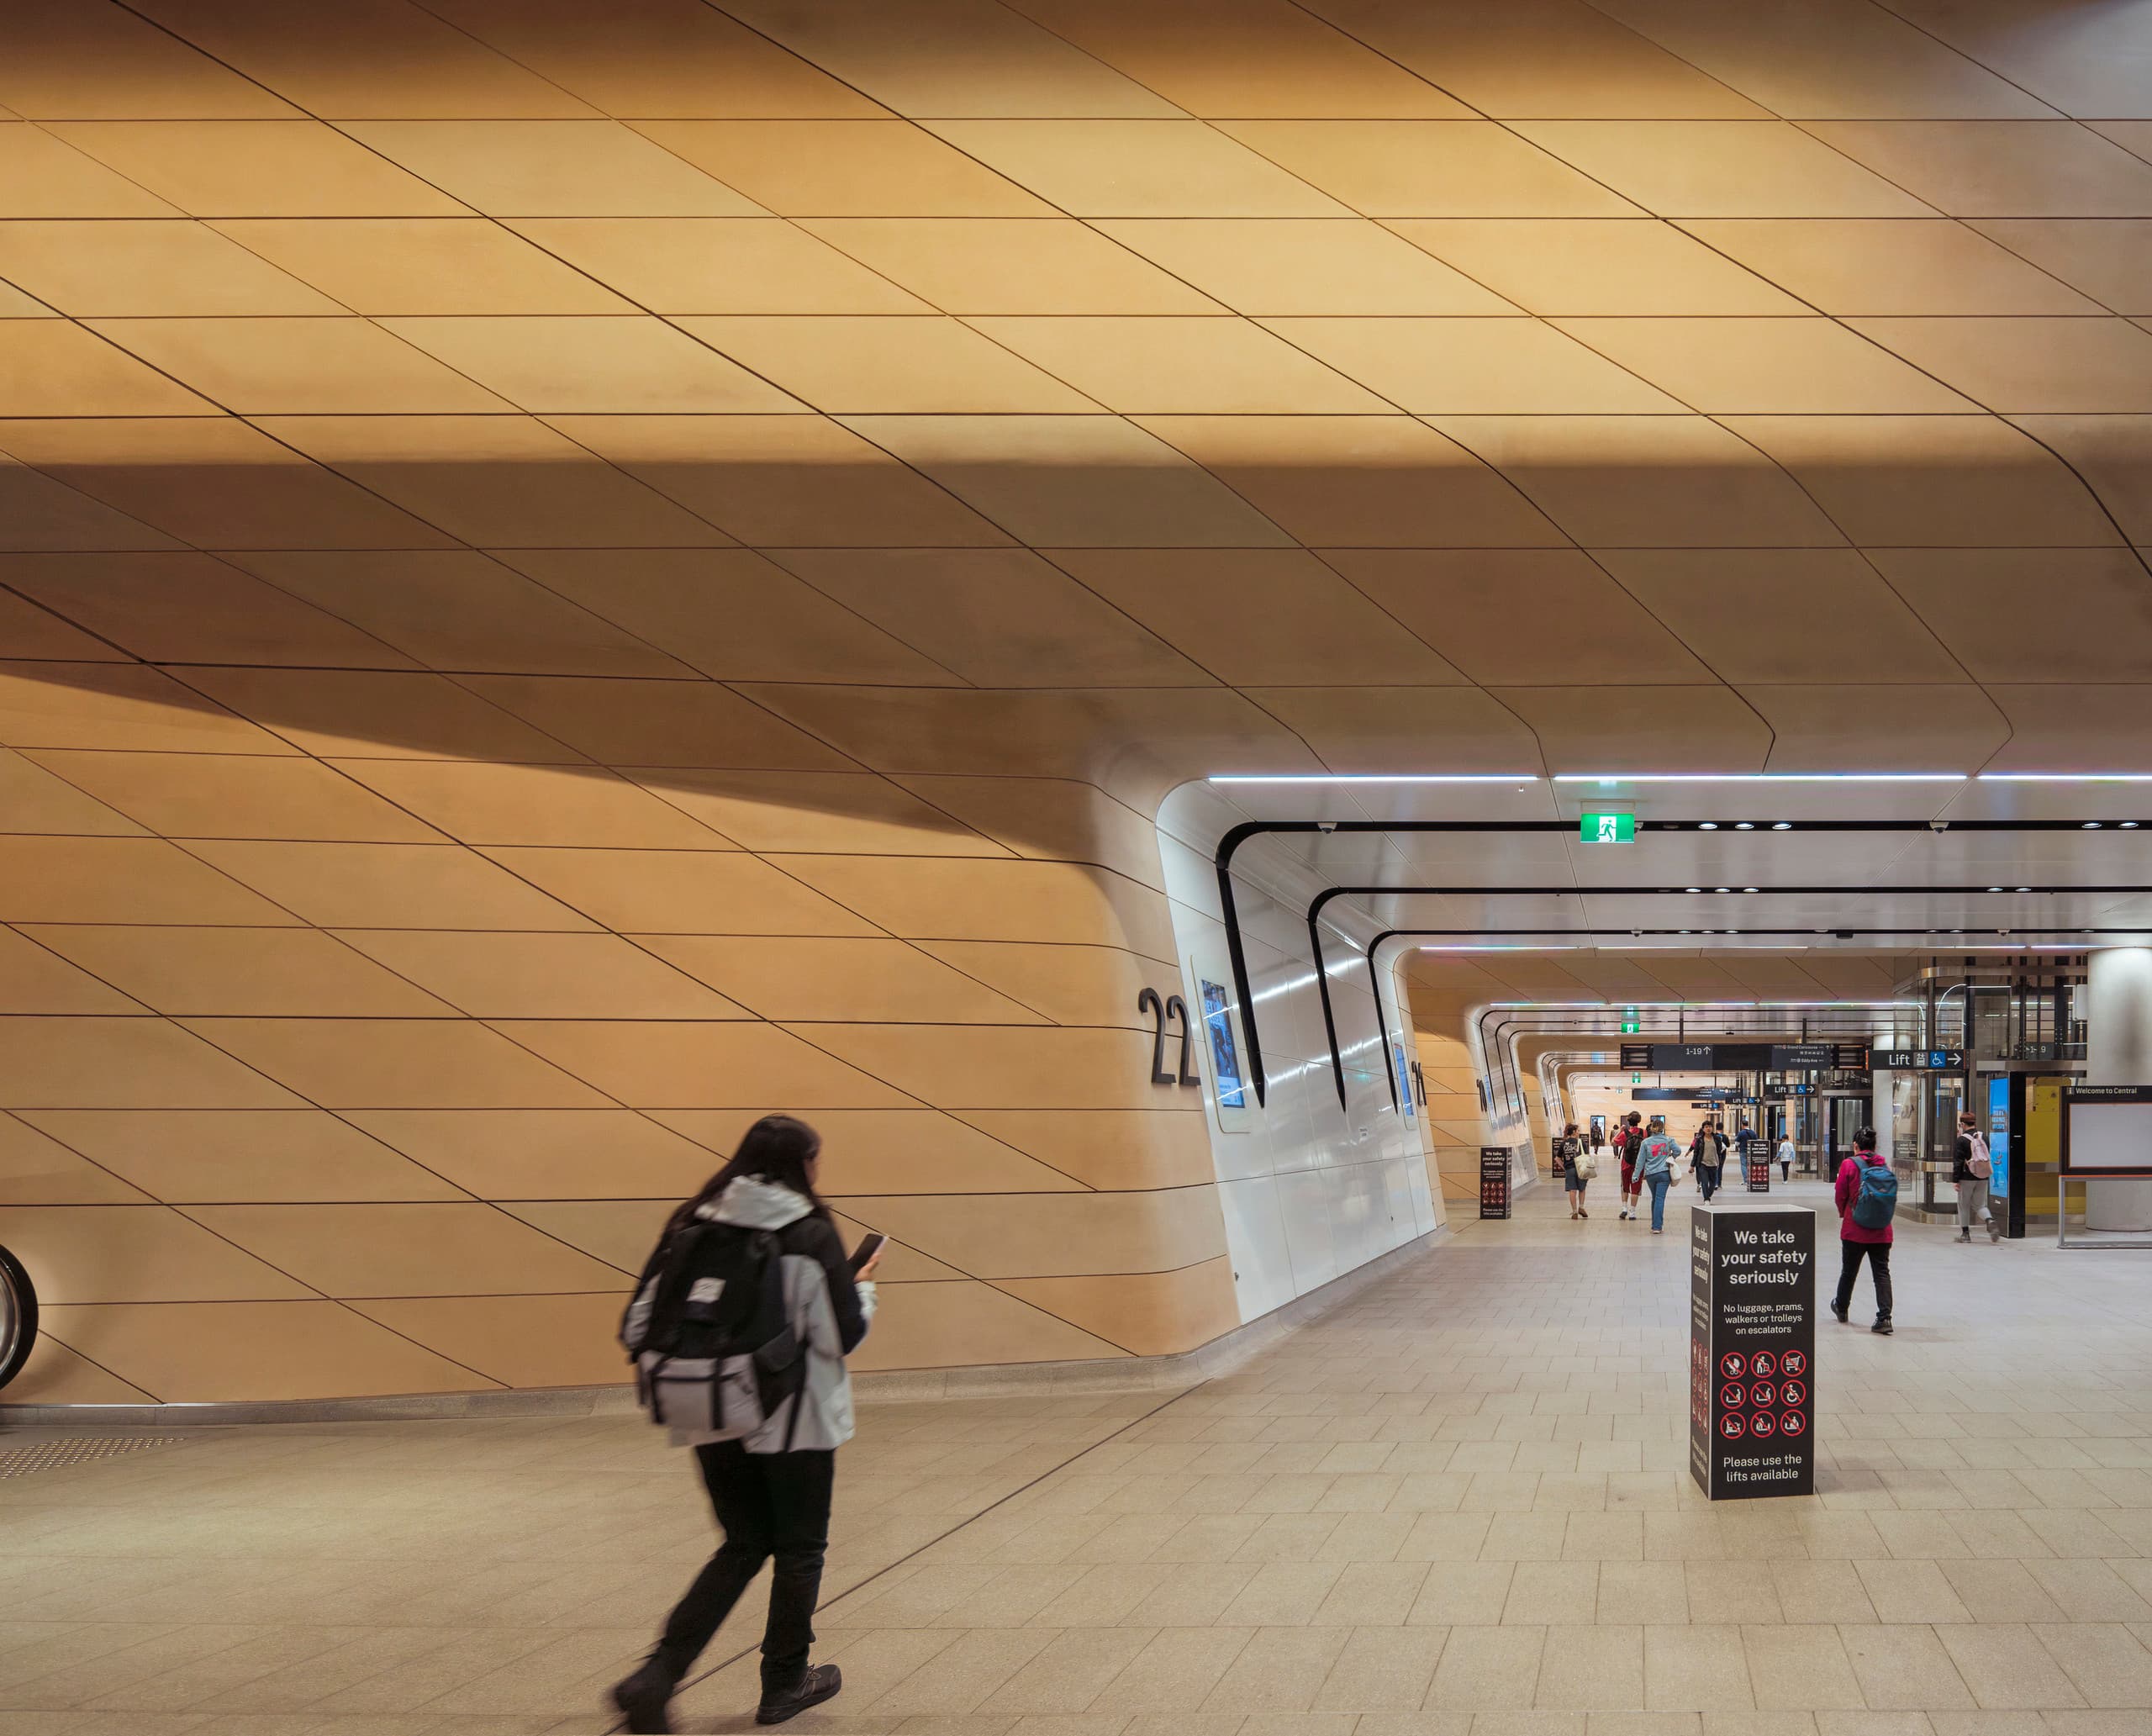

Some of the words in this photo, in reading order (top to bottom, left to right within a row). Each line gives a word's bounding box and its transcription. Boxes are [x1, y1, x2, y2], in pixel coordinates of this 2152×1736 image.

[1138, 987, 1201, 1085] 22
[1889, 1054, 1910, 1065] Lift
[1734, 1231, 1758, 1244] We
[1761, 1230, 1796, 1243] take
[1721, 1253, 1755, 1267] your
[1759, 1250, 1807, 1265] safety
[1729, 1269, 1799, 1285] seriously
[1738, 1304, 1774, 1313] luggage,
[1776, 1303, 1804, 1312] prams,
[1725, 1315, 1758, 1323] walkers
[1771, 1314, 1802, 1323] trolleys
[1748, 1326, 1791, 1334] escalators
[1723, 1457, 1759, 1467] Please
[1785, 1454, 1801, 1464] the
[1727, 1471, 1748, 1482] lifts
[1750, 1469, 1798, 1481] available
